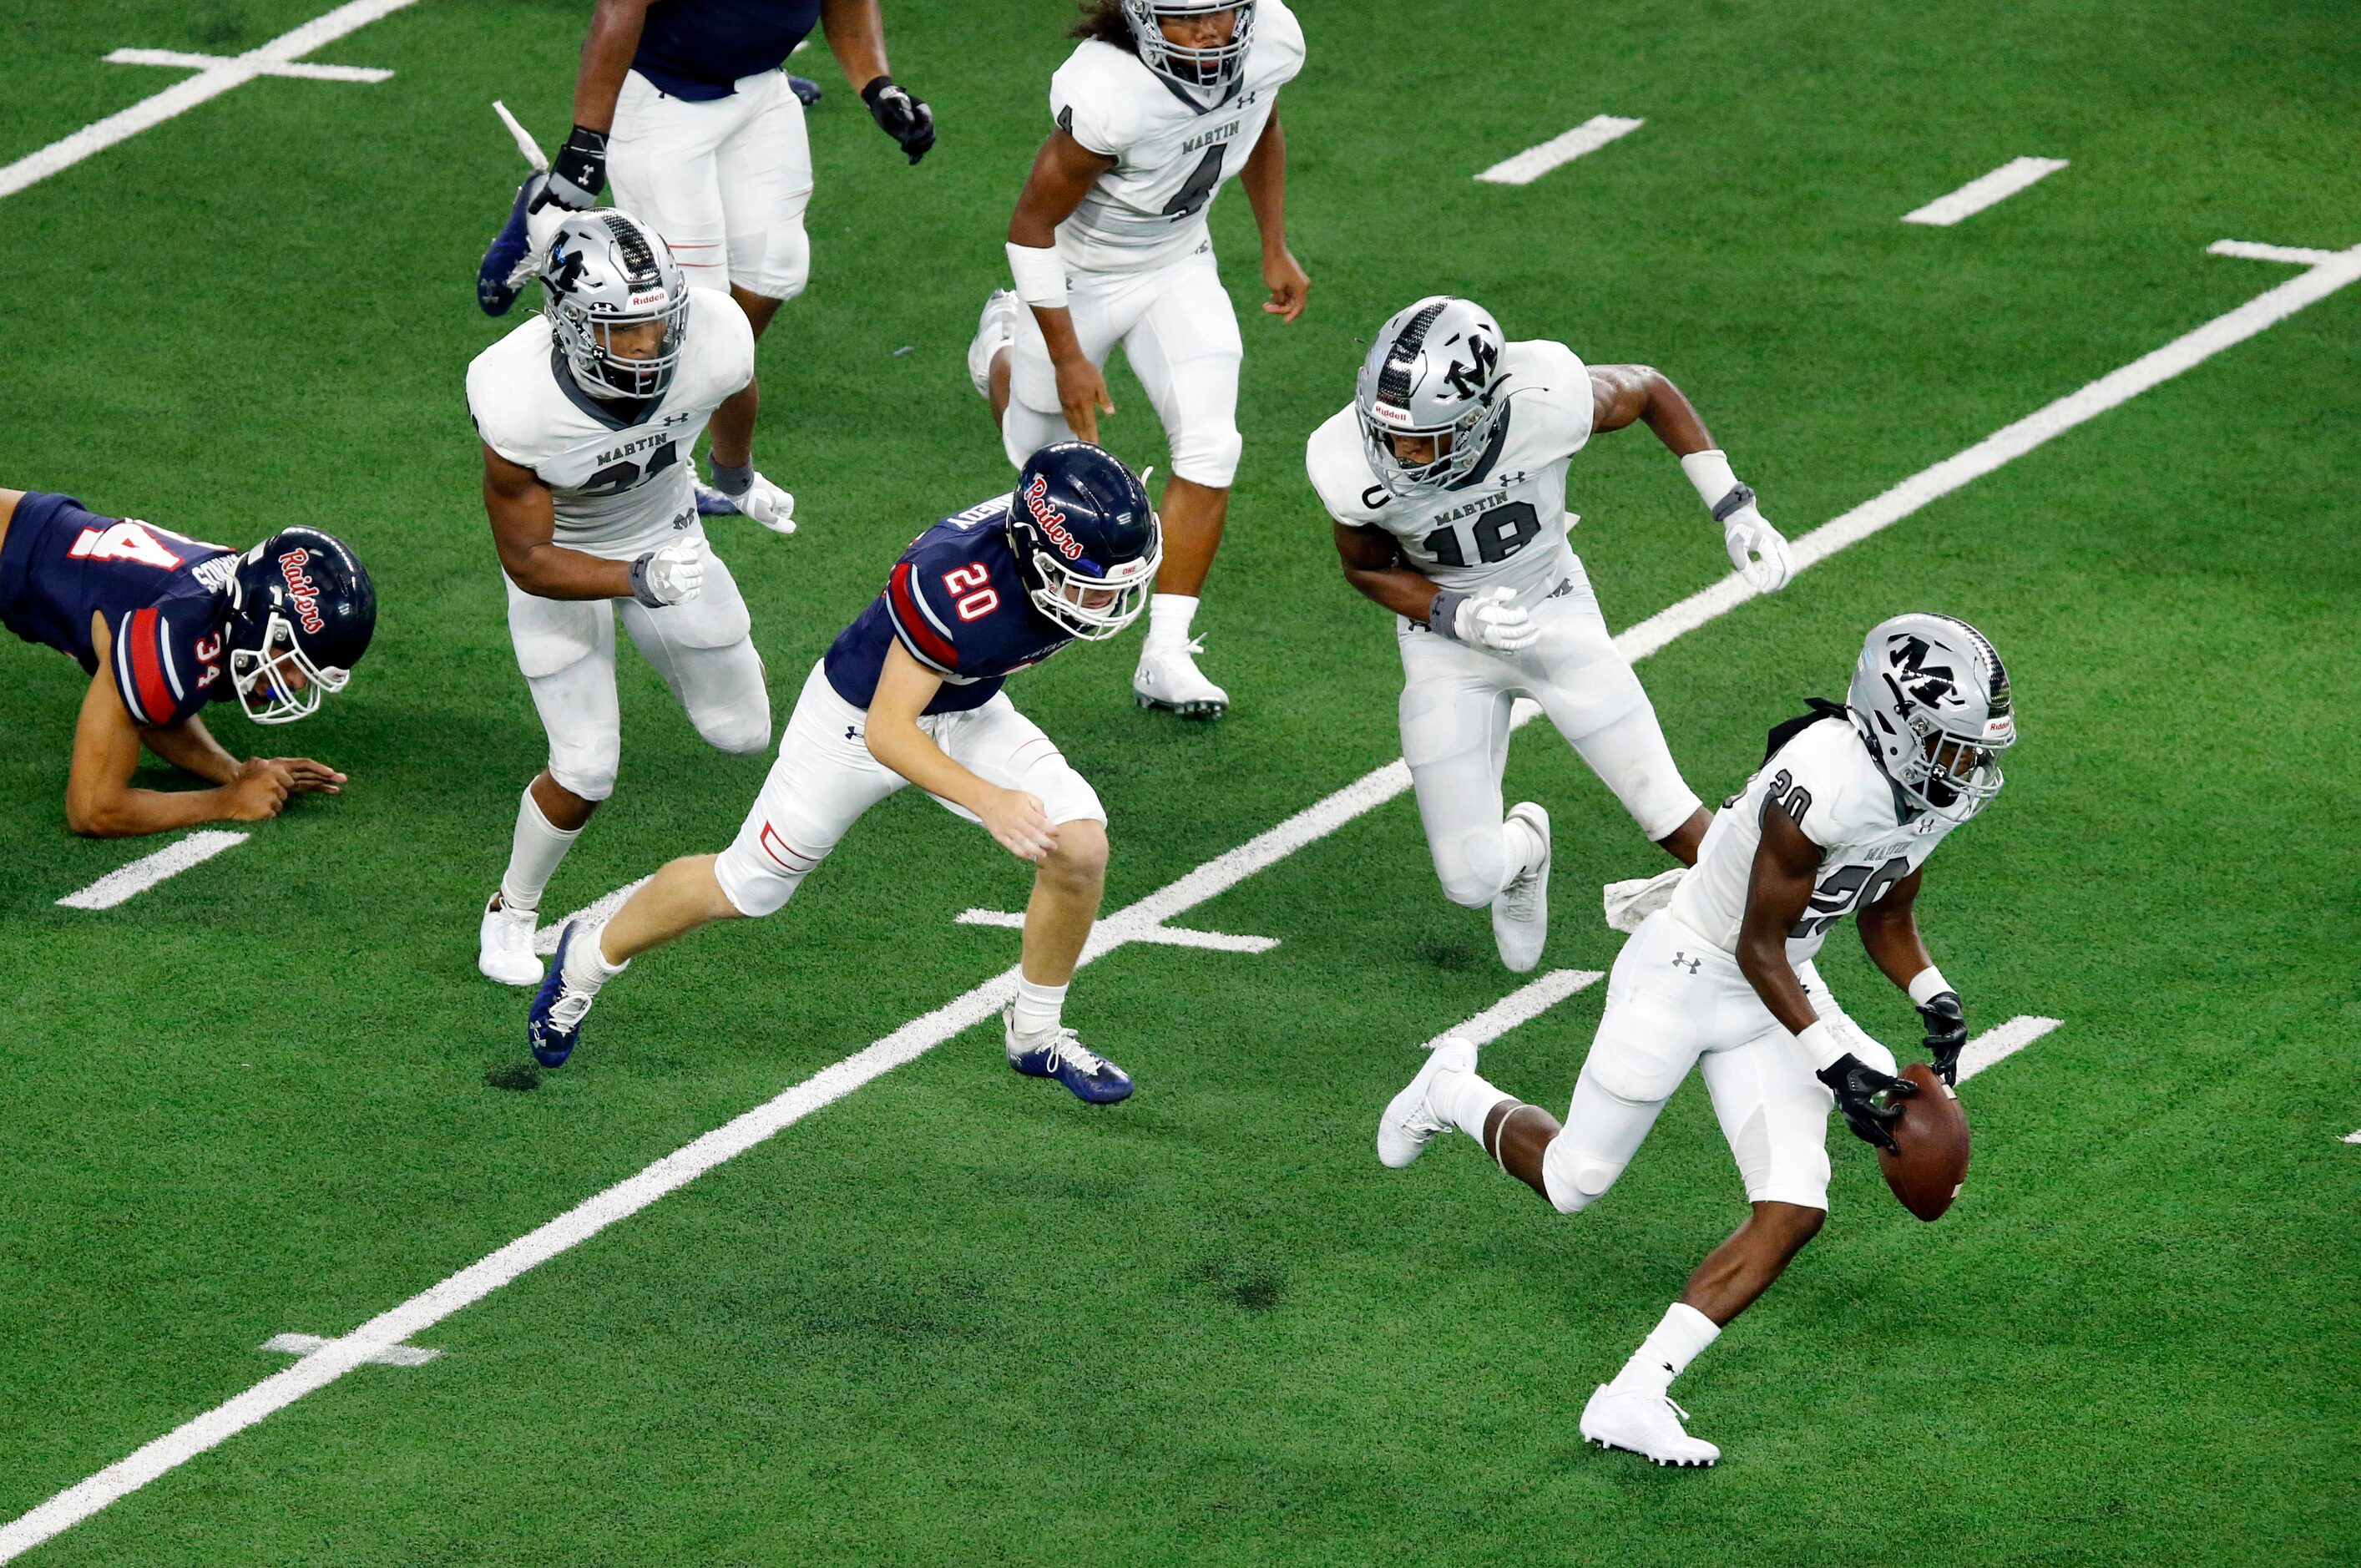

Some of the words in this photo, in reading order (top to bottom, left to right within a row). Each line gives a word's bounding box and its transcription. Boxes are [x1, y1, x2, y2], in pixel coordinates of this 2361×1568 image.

[1182, 120, 1241, 156] MARTIN
[633, 293, 665, 306] Riddell
[1375, 406, 1408, 421] Riddell
[596, 432, 668, 466] MARTIN
[1024, 476, 1084, 561] Raiders
[1434, 491, 1509, 526] MARTIN
[1122, 565, 1136, 575] ONE
[278, 548, 325, 635] Raiders
[942, 561, 1001, 622] 20
[195, 630, 221, 690] 34
